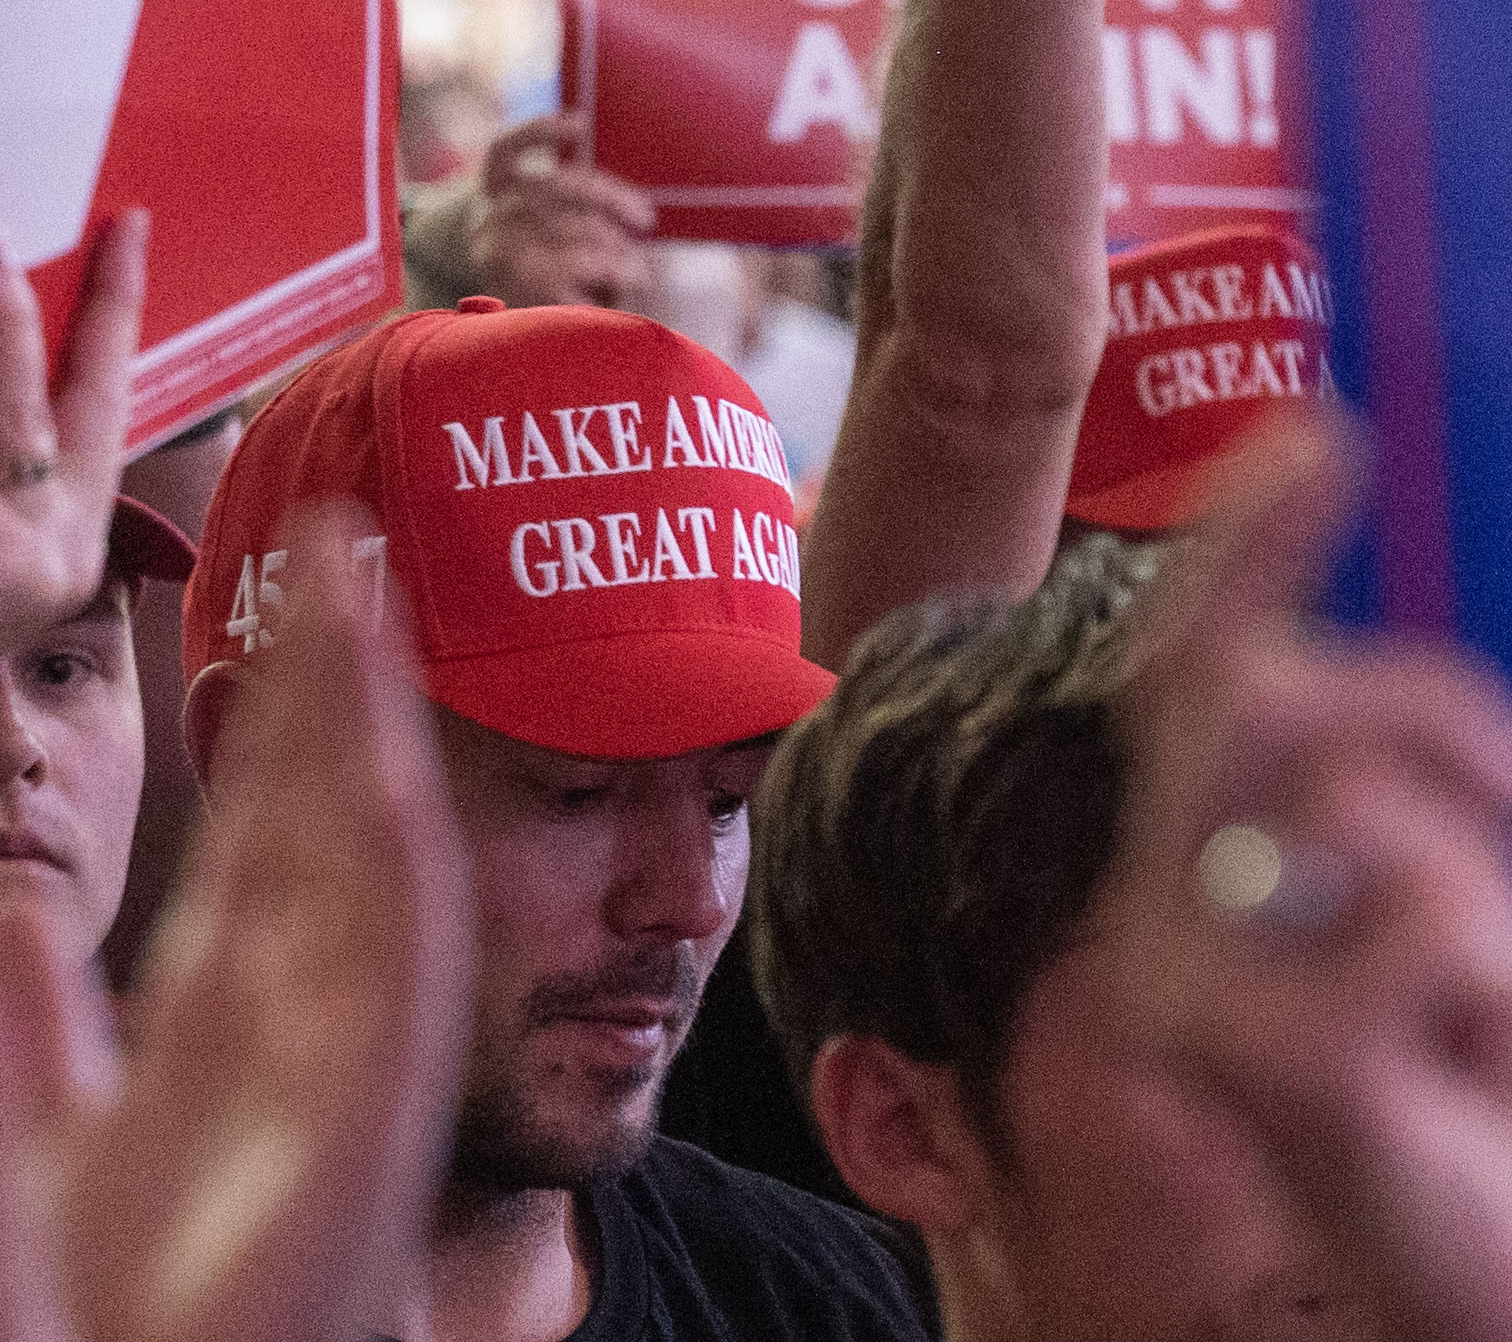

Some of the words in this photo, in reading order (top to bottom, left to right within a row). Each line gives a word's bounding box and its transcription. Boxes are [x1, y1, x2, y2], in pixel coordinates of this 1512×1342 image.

[1136, 340, 1305, 419] GREAT
[442, 400, 652, 492] MAKE
[510, 506, 718, 599] GREAT
